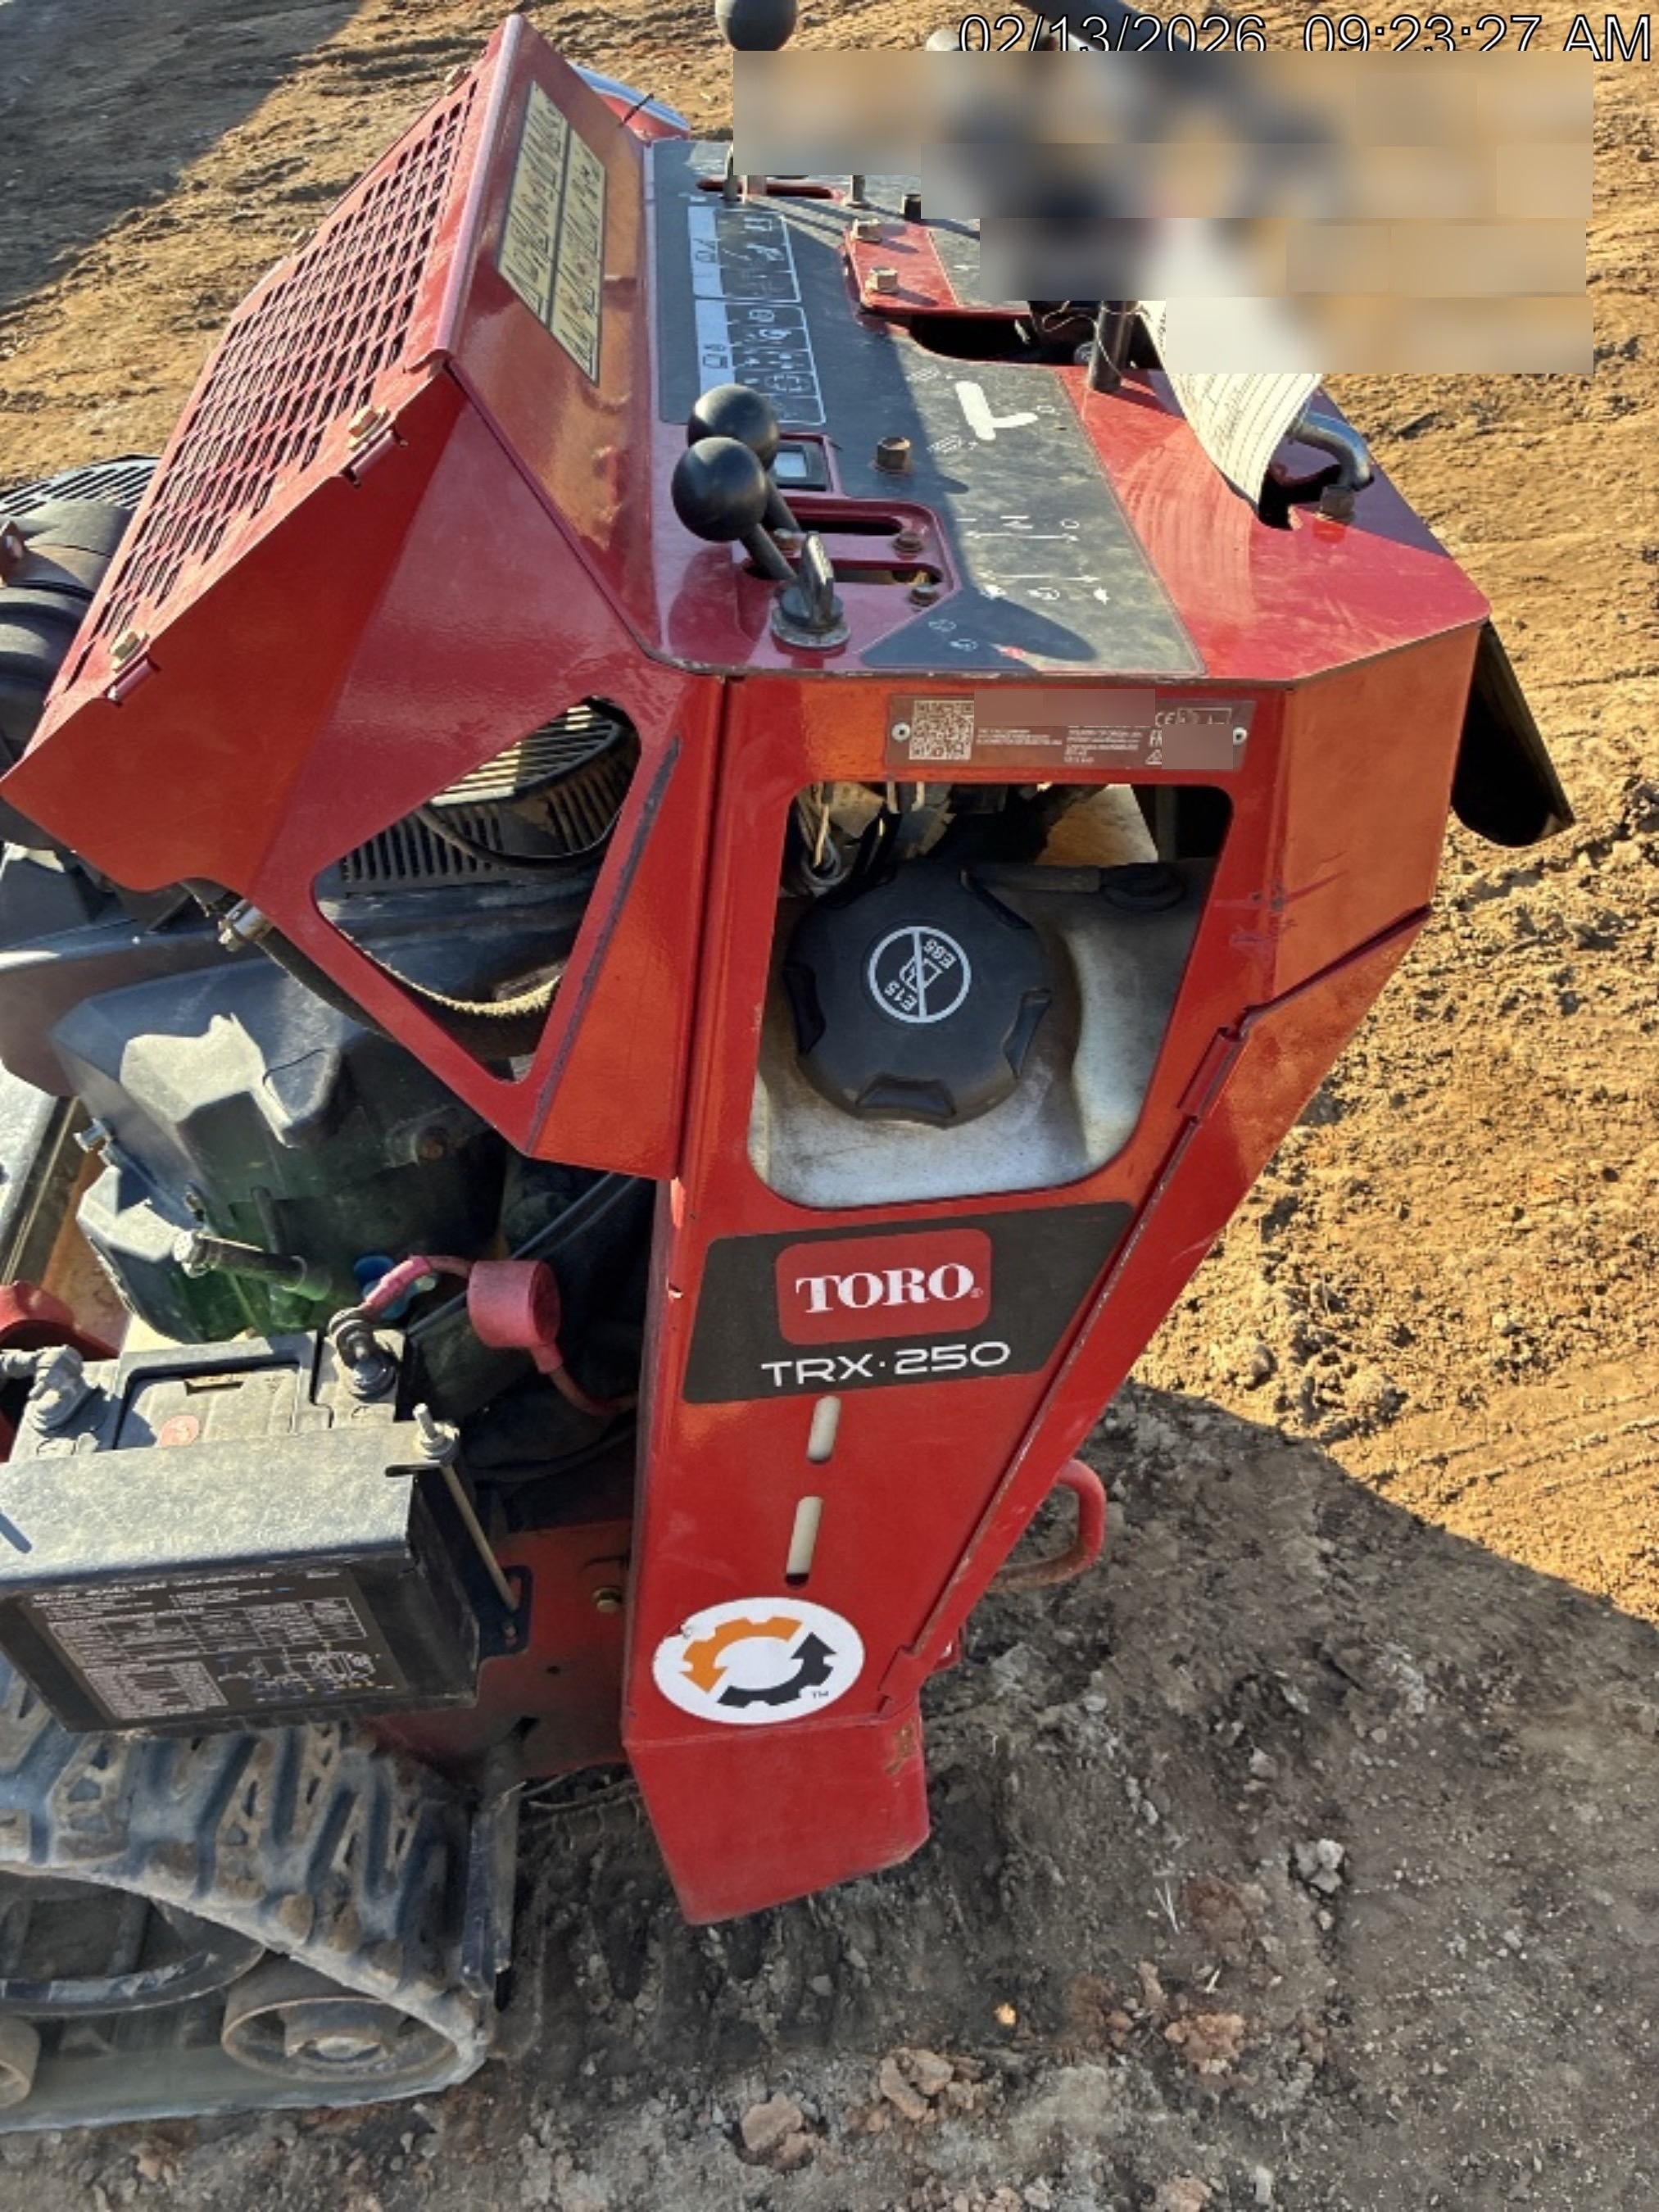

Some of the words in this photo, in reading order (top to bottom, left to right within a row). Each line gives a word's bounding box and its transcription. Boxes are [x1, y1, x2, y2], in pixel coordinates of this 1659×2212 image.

[923, 938, 957, 969] E85
[884, 980, 918, 1012] E15
[796, 1262, 975, 1312] TORO
